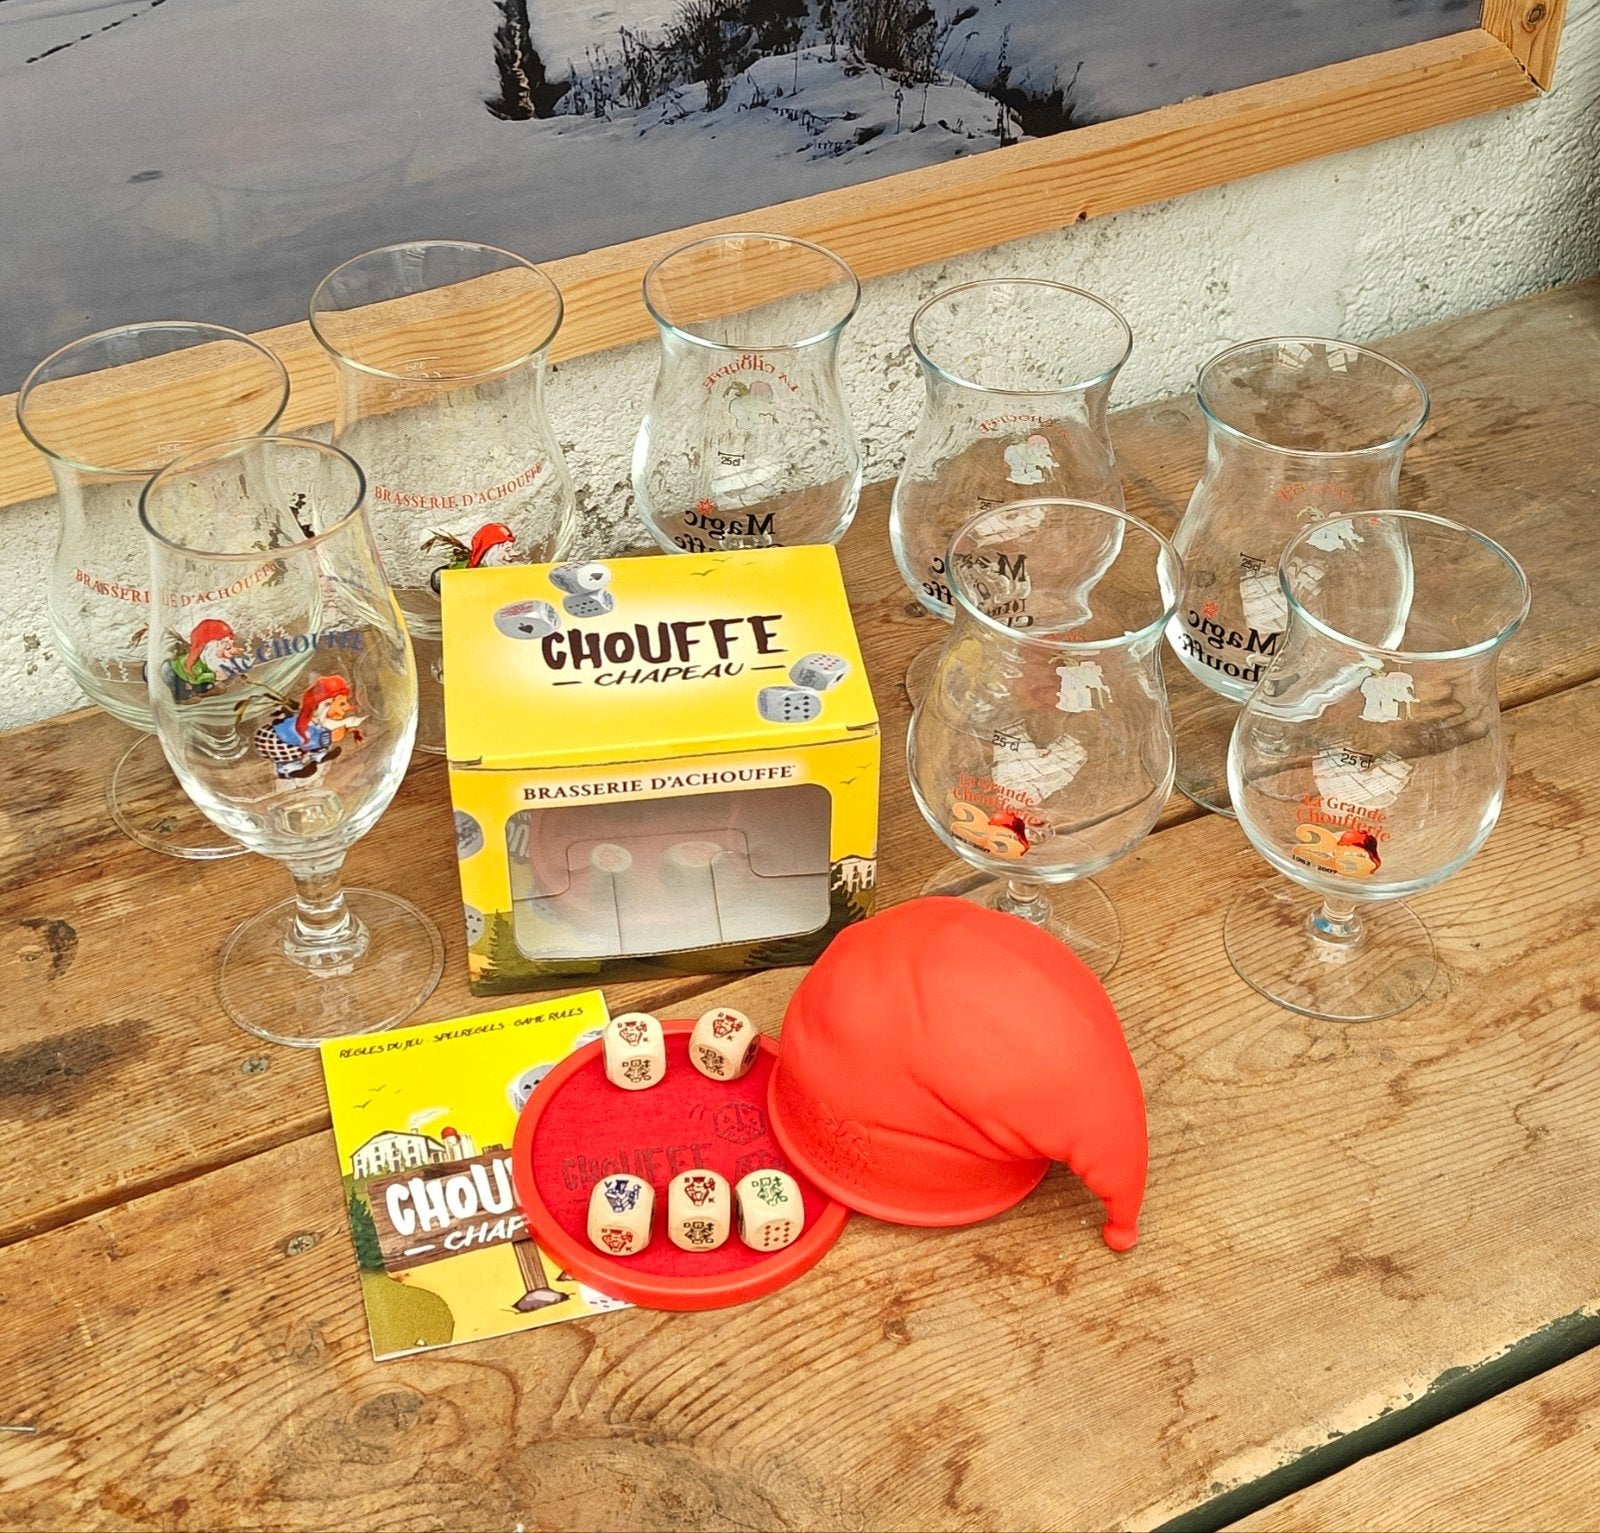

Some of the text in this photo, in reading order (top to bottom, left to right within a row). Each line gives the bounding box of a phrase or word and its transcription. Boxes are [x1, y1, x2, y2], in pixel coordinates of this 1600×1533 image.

[374, 485, 458, 510] BRASSERIE
[542, 614, 788, 670] CHOUFFE
[594, 663, 744, 686] CHAPEAU
[1341, 752, 1357, 766] 25
[523, 766, 793, 800] BRASSERIE D'ACHOUFFE
[1327, 796, 1387, 823] Grande
[514, 1007, 584, 1027] GAME RULES
[433, 1023, 505, 1043] SPELREGELS
[385, 1157, 513, 1236] CHOU
